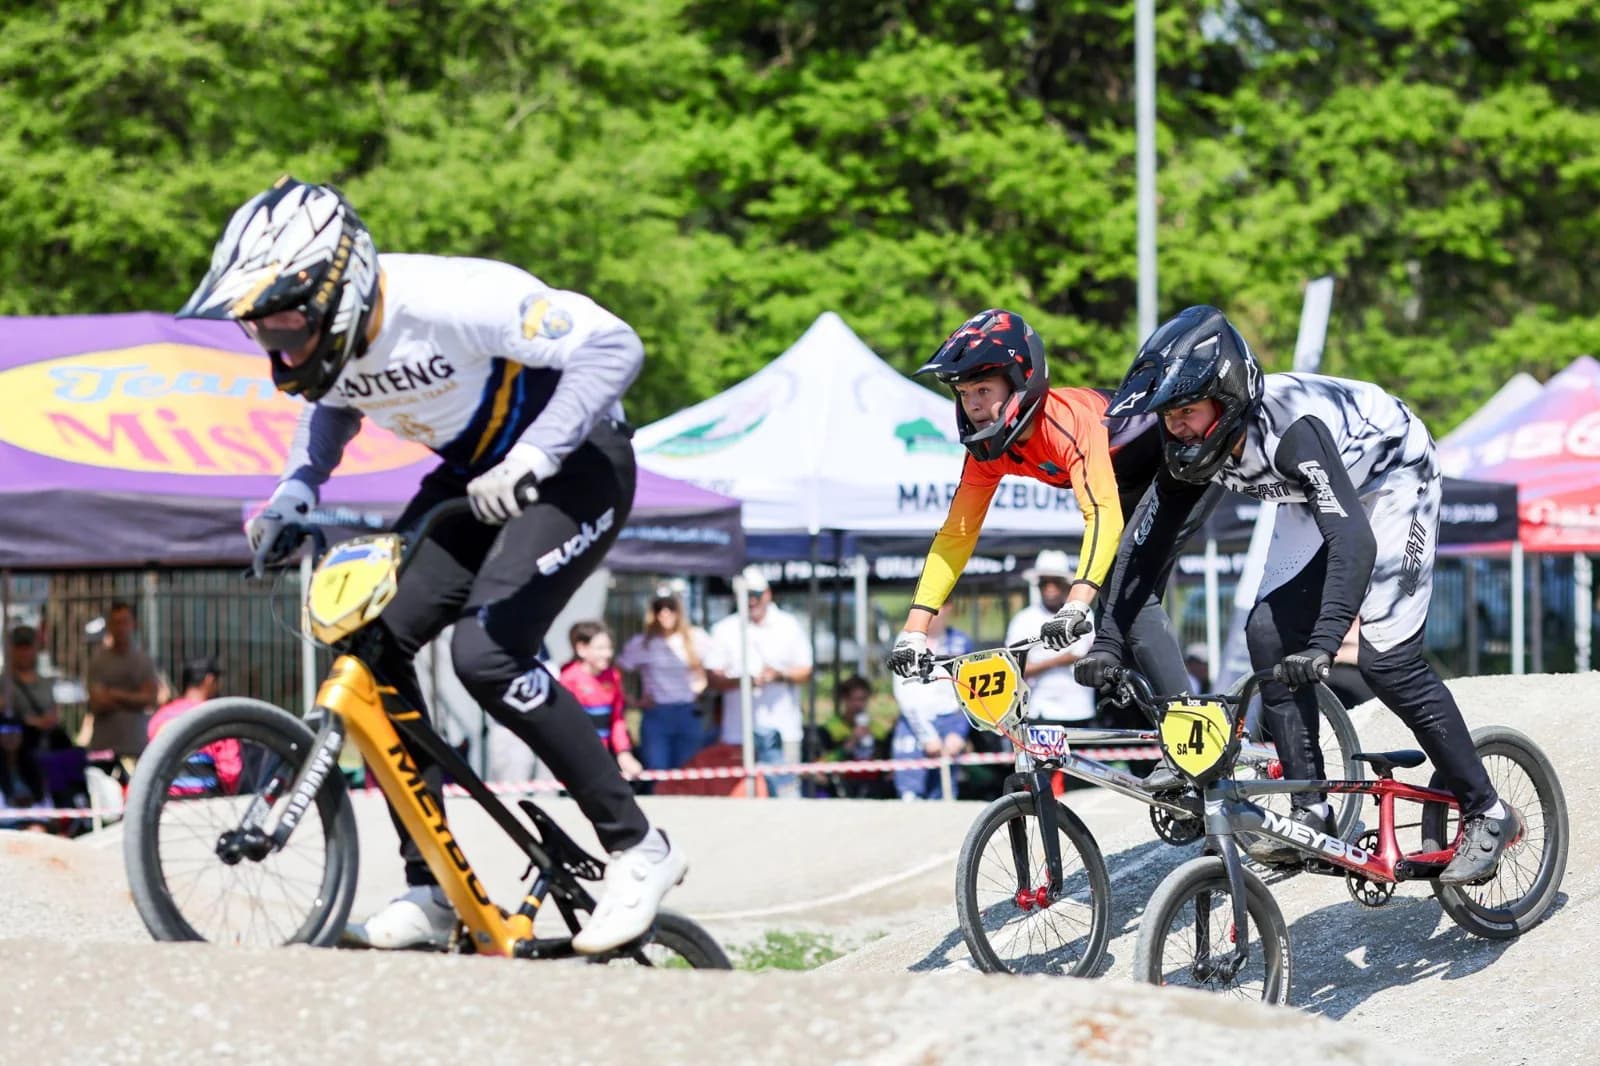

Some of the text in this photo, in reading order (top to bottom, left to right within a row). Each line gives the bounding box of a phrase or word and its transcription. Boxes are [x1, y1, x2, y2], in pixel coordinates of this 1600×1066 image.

[335, 354, 456, 398] AUTENG
[968, 670, 1006, 700] 123
[1188, 719, 1205, 755] 4
[388, 743, 491, 906] MEYBO
[1261, 808, 1369, 866] MEYBO
